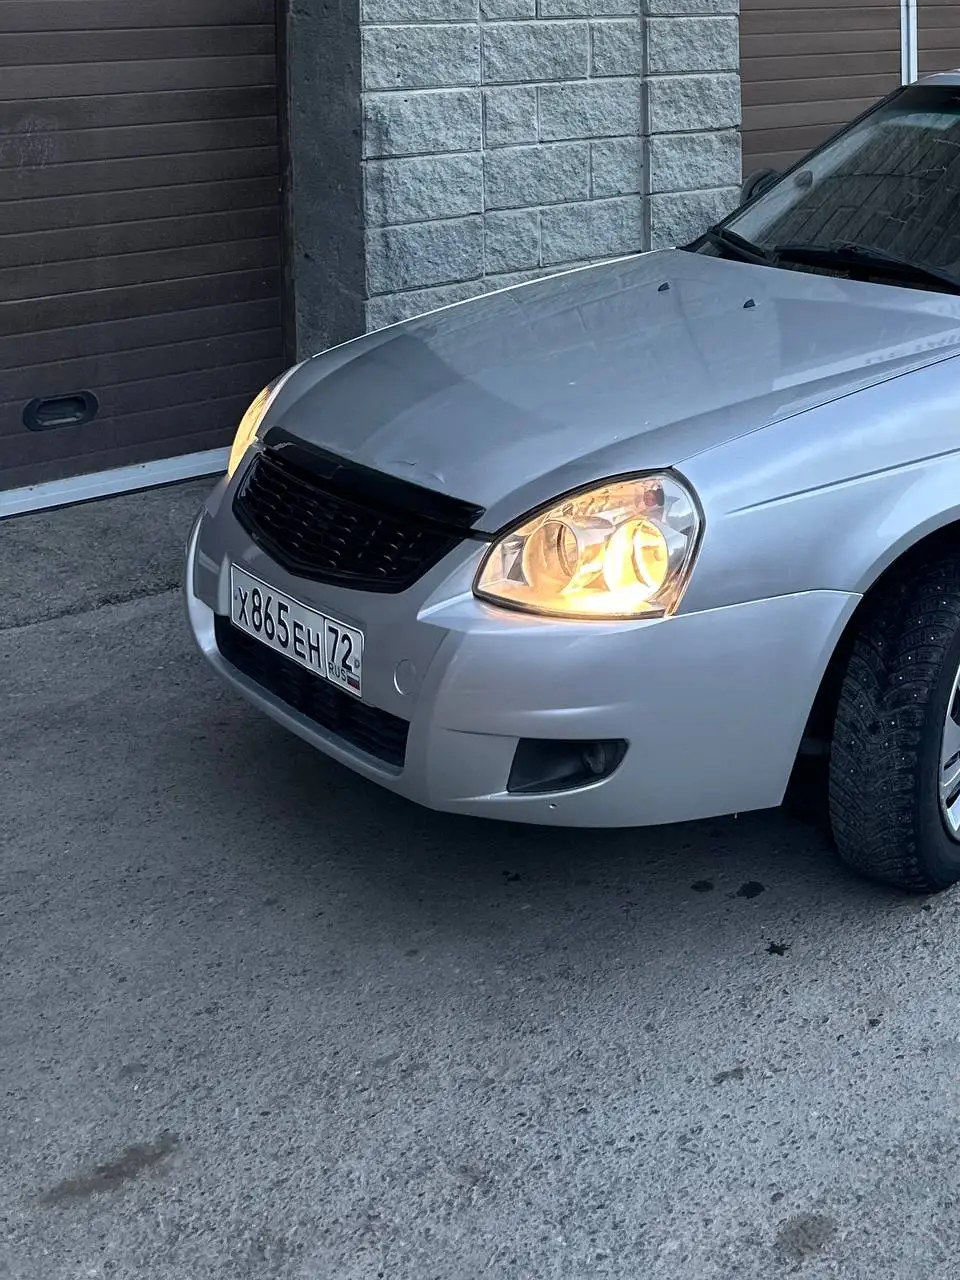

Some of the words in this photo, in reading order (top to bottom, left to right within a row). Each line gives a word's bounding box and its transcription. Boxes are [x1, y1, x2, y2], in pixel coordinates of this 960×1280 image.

[238, 586, 322, 669] Х865ЕН
[328, 625, 353, 674] 72
[328, 661, 347, 682] RUS
